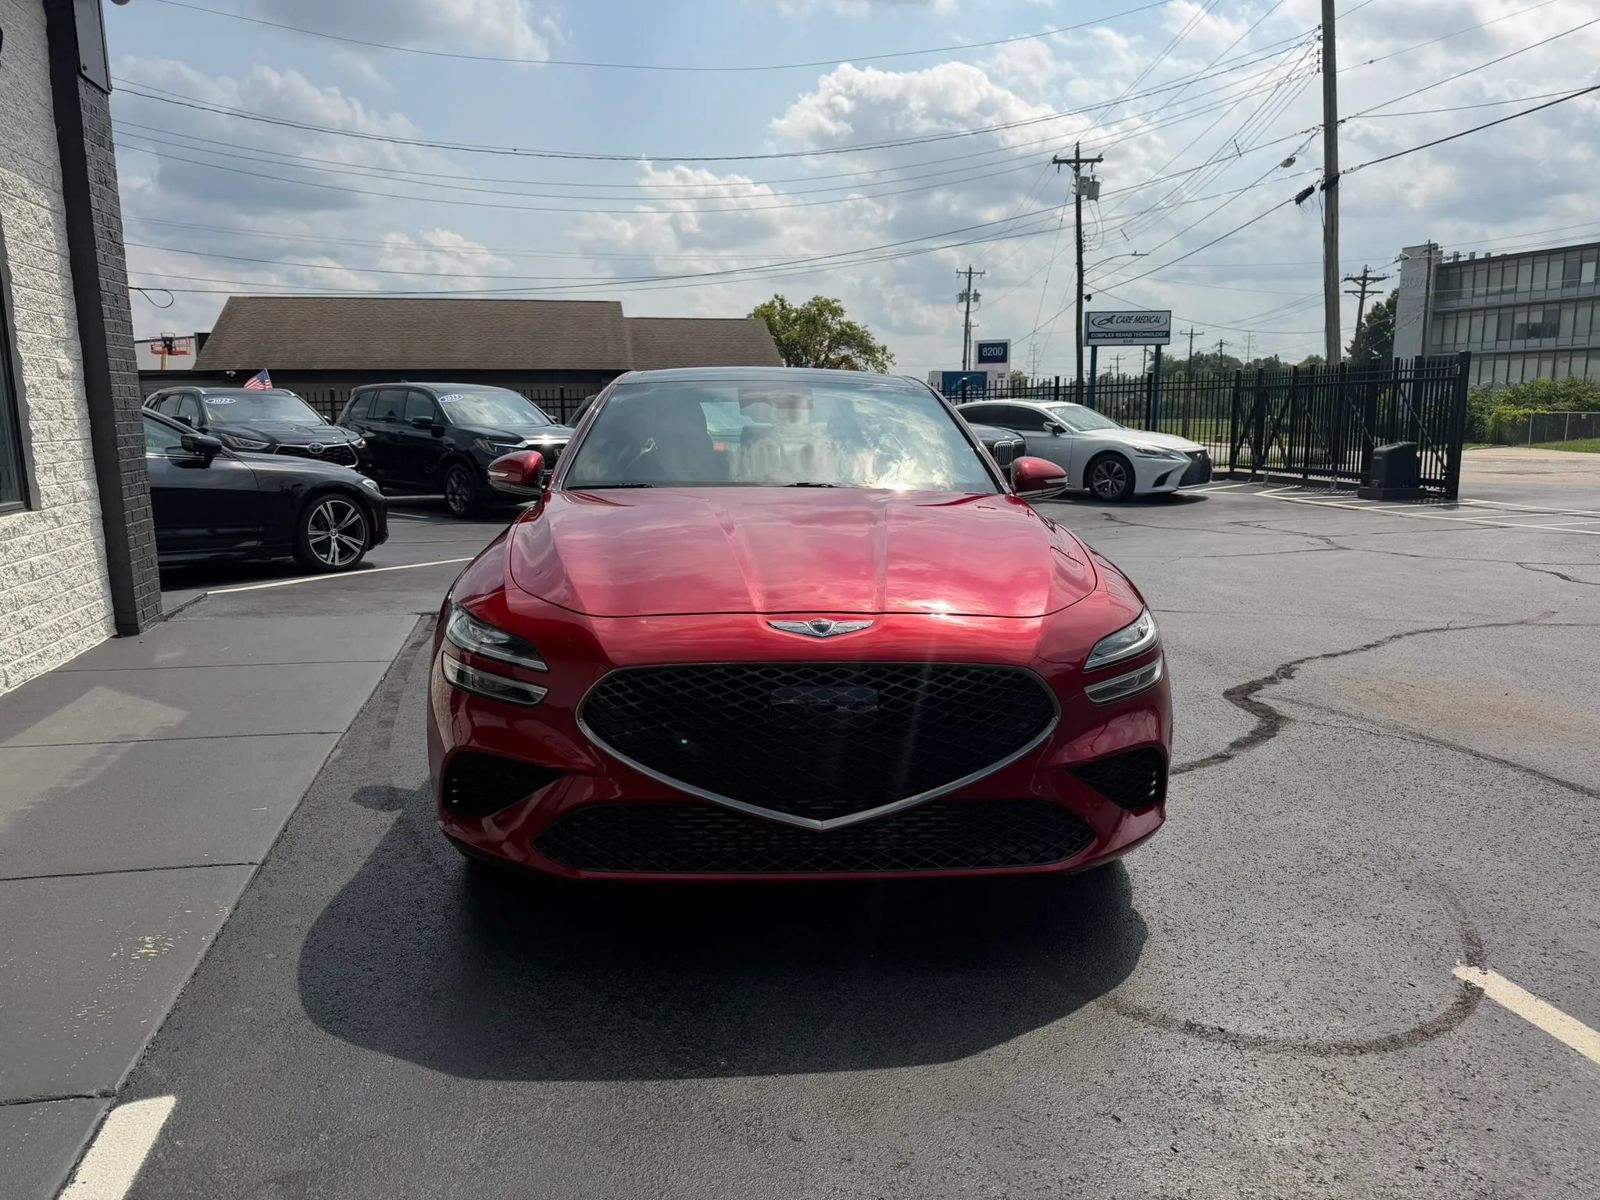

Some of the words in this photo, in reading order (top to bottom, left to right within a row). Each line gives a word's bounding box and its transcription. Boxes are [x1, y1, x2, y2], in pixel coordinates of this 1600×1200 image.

[1115, 315, 1133, 324] CARE
[1133, 315, 1162, 324] MEDICAL
[982, 346, 1003, 357] 8200
